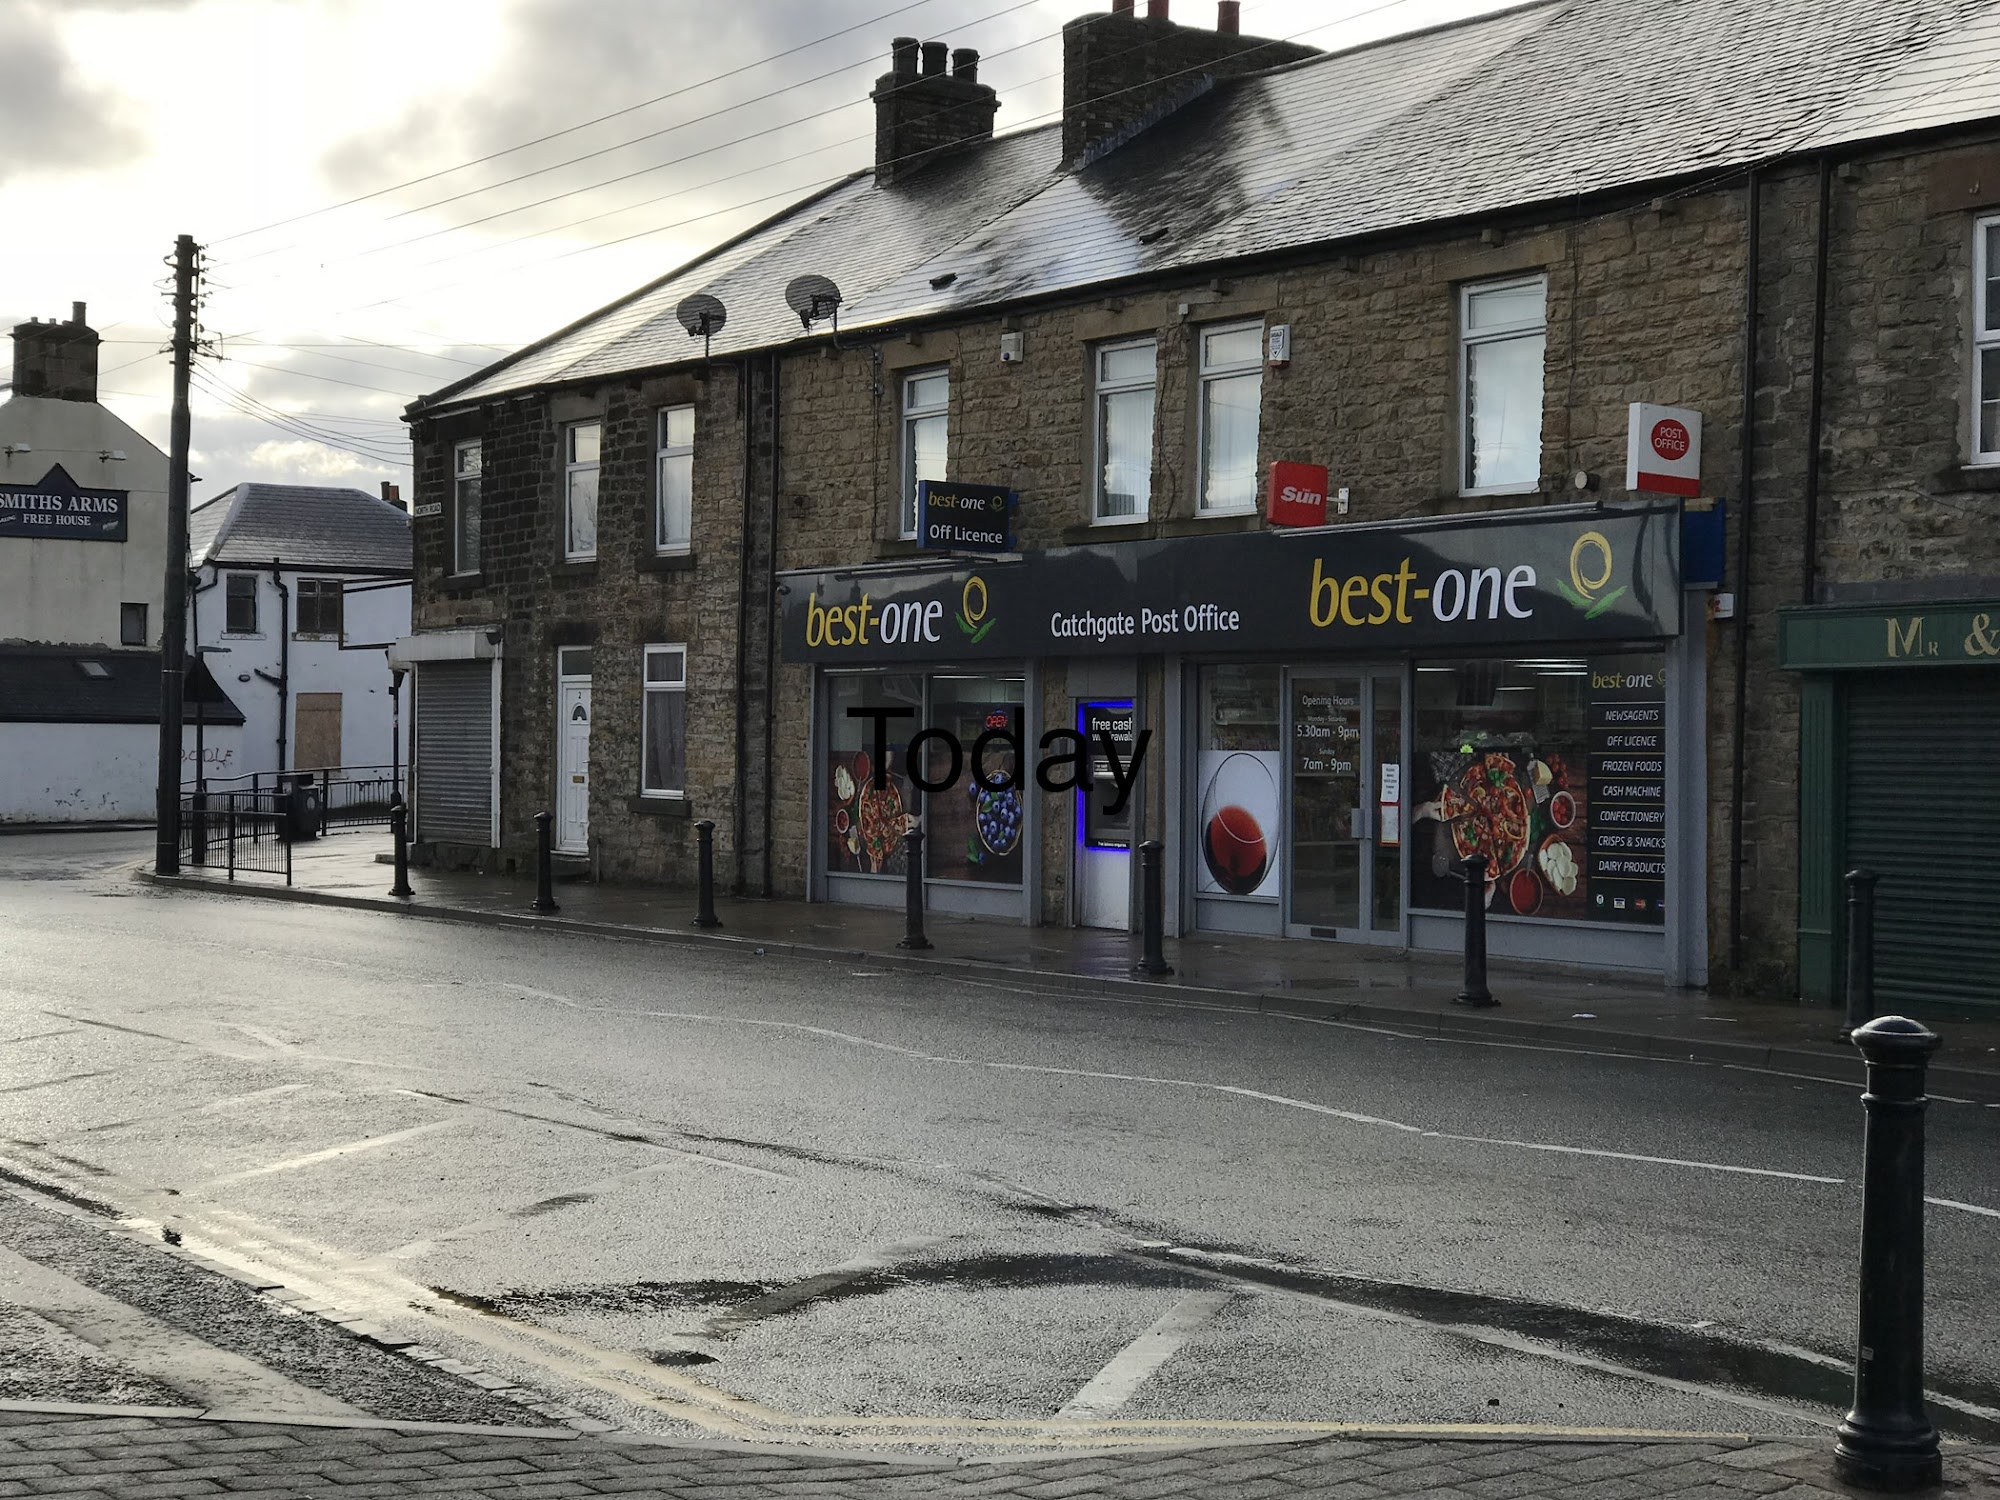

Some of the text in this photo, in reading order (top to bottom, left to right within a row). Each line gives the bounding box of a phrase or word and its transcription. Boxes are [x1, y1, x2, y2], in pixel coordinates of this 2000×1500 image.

[1660, 427, 1683, 439] POST
[1654, 437, 1685, 451] OFFICE
[928, 491, 986, 511] best-one
[1280, 486, 1322, 506] Sun
[67, 496, 119, 514] ARMS
[23, 513, 53, 525] FREE
[55, 515, 92, 526] HOUSE
[929, 524, 1003, 544] Off Licence
[1309, 555, 1537, 628] best-one
[806, 591, 943, 647] best-one
[1051, 603, 1240, 643] Catchgate Post Office
[1964, 613, 2000, 657] &
[1592, 671, 1654, 689] best-one
[1302, 695, 1355, 708] Opening Hours
[985, 715, 1008, 728] OPEN
[1605, 710, 1659, 721] NEWSAGENTS
[1092, 717, 1111, 731] free
[1297, 724, 1331, 738] 5.30am
[1337, 725, 1359, 741] 9pm
[1607, 735, 1657, 747] OFF LICENCE
[1303, 757, 1324, 771] 7am
[1330, 758, 1352, 774] 9pm
[1602, 761, 1662, 772] FROZEN FOODS
[1602, 785, 1661, 797] CASH MACHINE
[1600, 810, 1665, 823] CONFECTIONERY
[1598, 835, 1666, 849] CRISPS & SNACKS
[1598, 860, 1666, 874] DAIRY PRODUCTS
